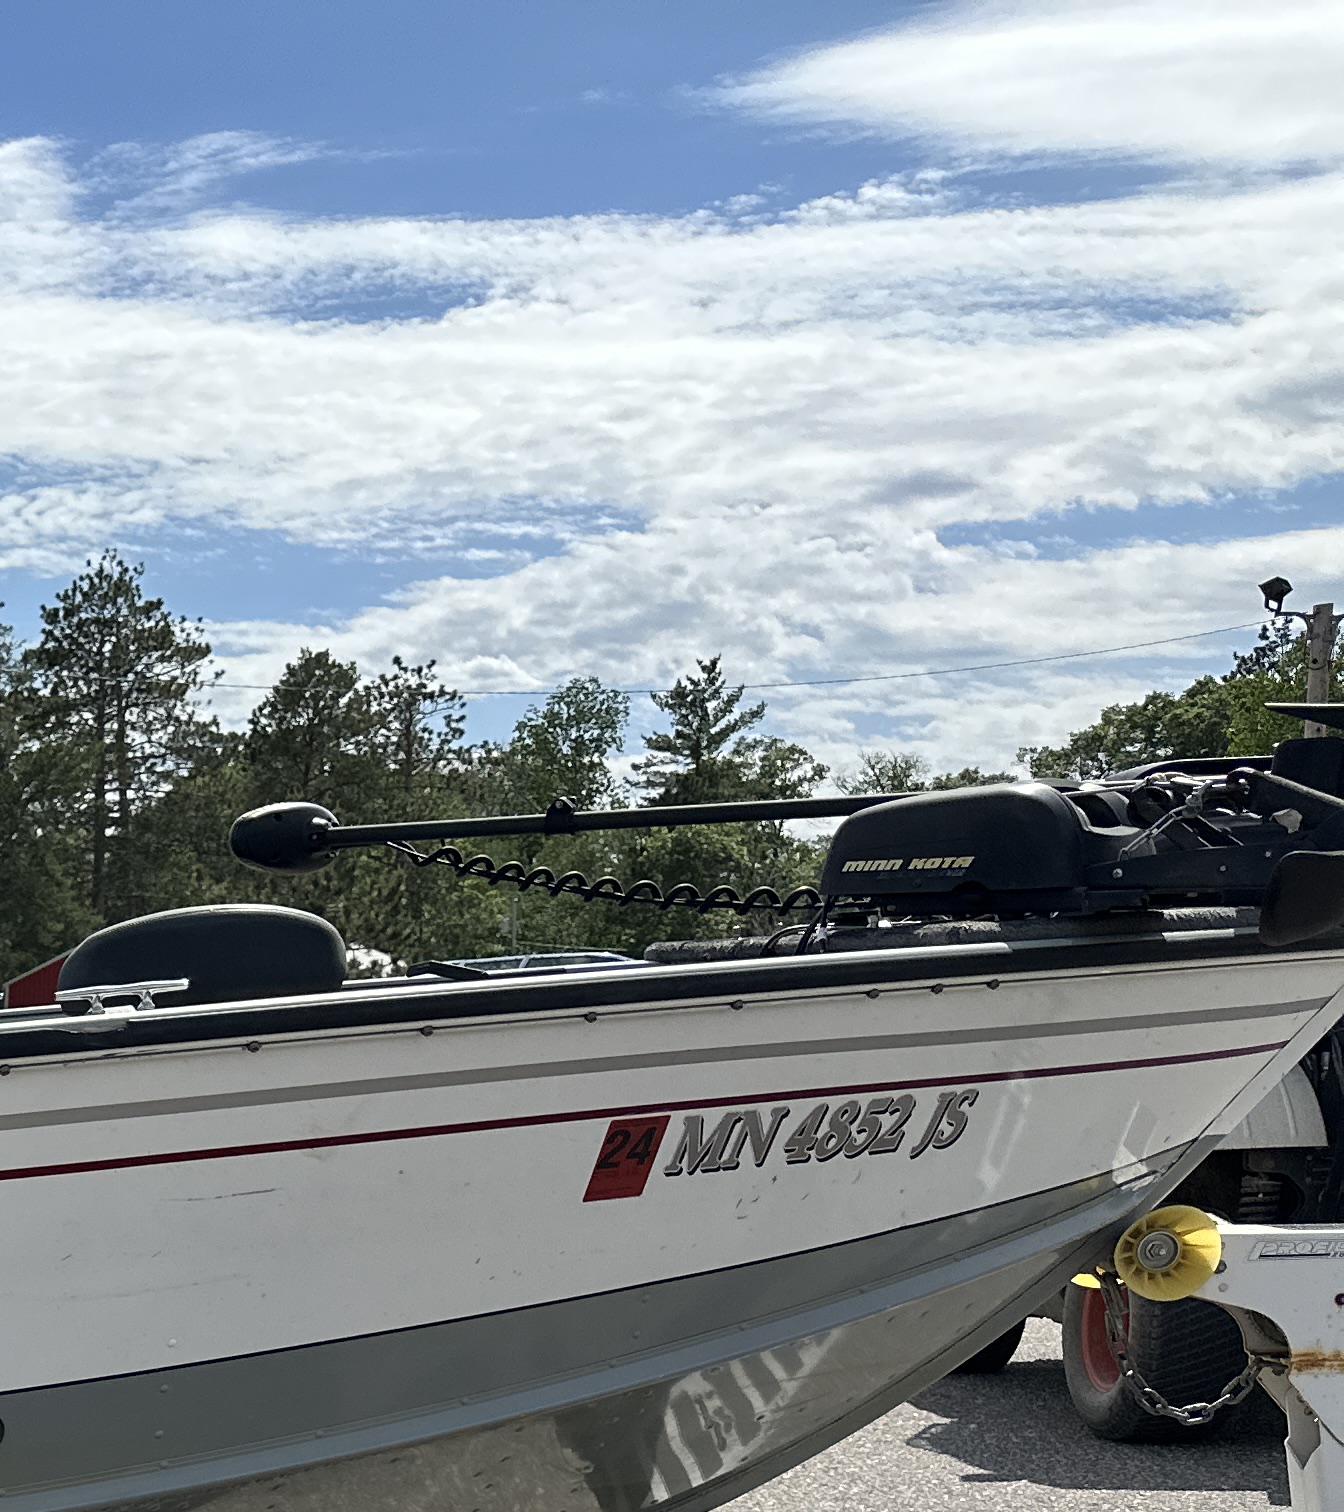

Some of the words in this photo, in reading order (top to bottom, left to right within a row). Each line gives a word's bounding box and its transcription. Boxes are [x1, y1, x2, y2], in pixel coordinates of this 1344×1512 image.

[907, 855, 976, 870] KOTA
[596, 1126, 658, 1171] 24
[664, 1105, 791, 1177] MN
[783, 1093, 917, 1165] 4852
[910, 1088, 980, 1160] JS
